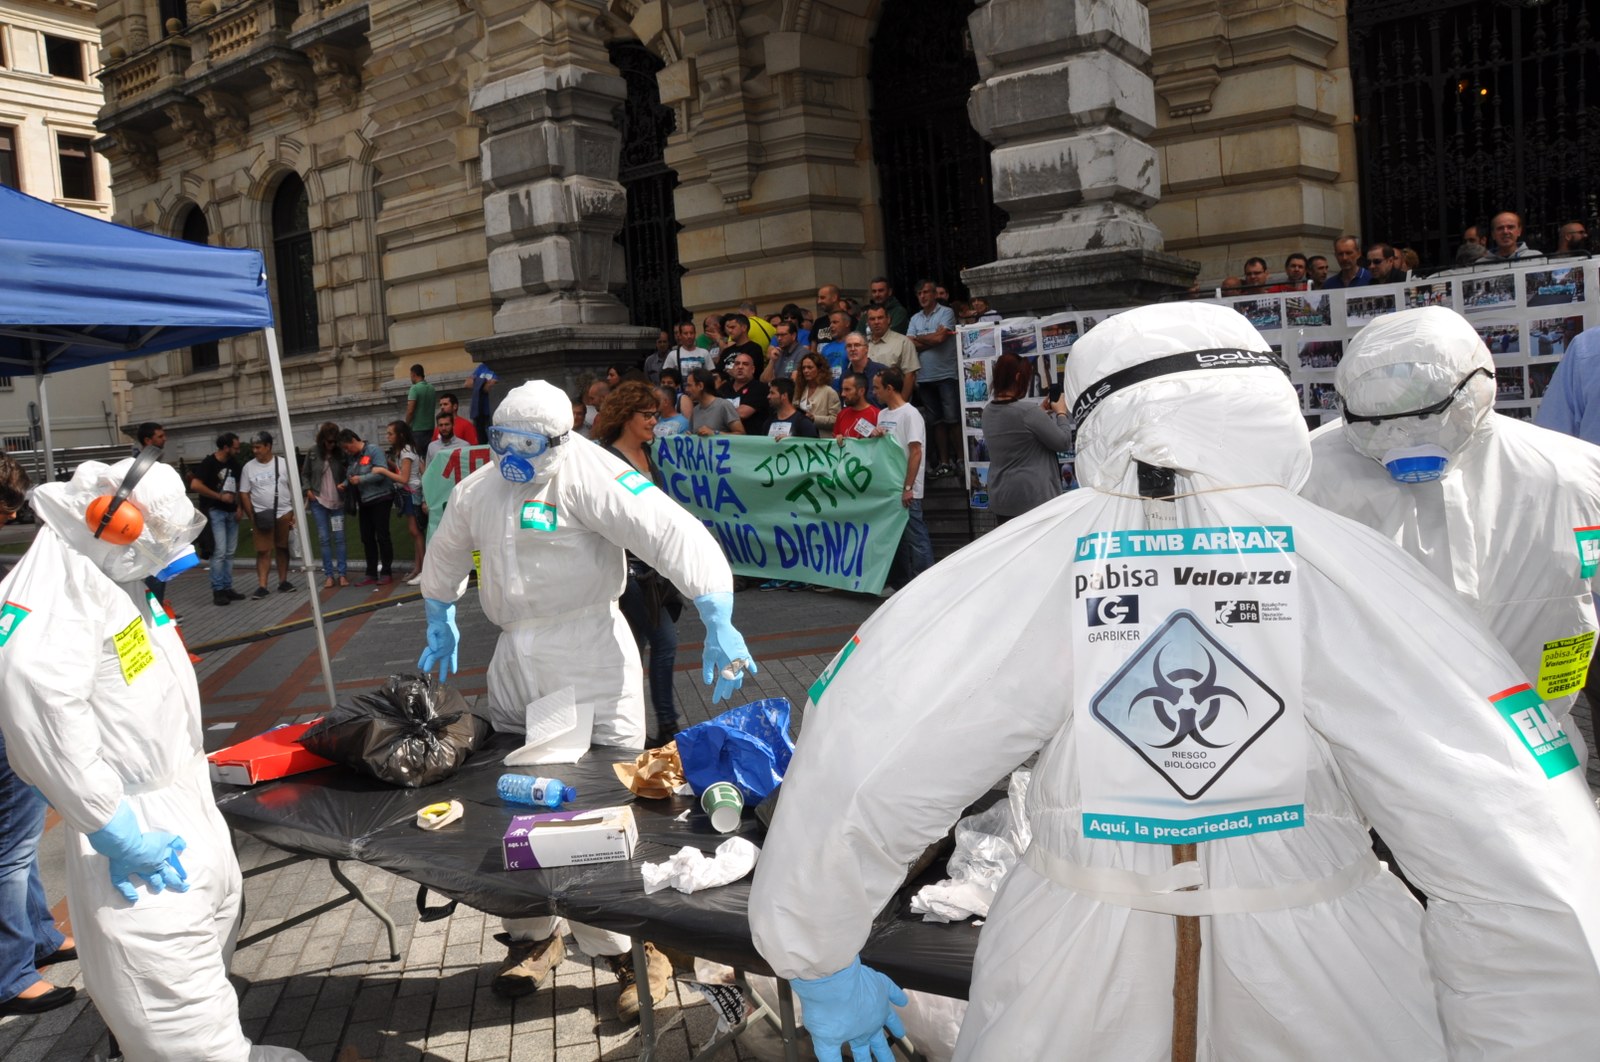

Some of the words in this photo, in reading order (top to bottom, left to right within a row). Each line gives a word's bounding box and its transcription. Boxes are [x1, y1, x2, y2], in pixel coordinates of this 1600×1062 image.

[658, 436, 731, 476] ARRAIZ
[785, 456, 872, 514] TMB
[1079, 535, 1121, 557] UTE
[1129, 534, 1184, 551] TMB
[1192, 531, 1288, 550] ARRAIZ
[1075, 564, 1159, 599] pabisa
[1173, 566, 1291, 586] Valoriza
[1239, 603, 1257, 611] BFA
[1240, 612, 1258, 620] DFB
[1088, 630, 1140, 643] GARBIKER
[1164, 760, 1216, 770] BIOLÓGICO
[1172, 752, 1207, 760] RIESGO
[1090, 819, 1131, 836] Aquí,
[1135, 822, 1149, 836] la
[1153, 816, 1253, 839] precariedad,
[1258, 810, 1299, 826] mata
